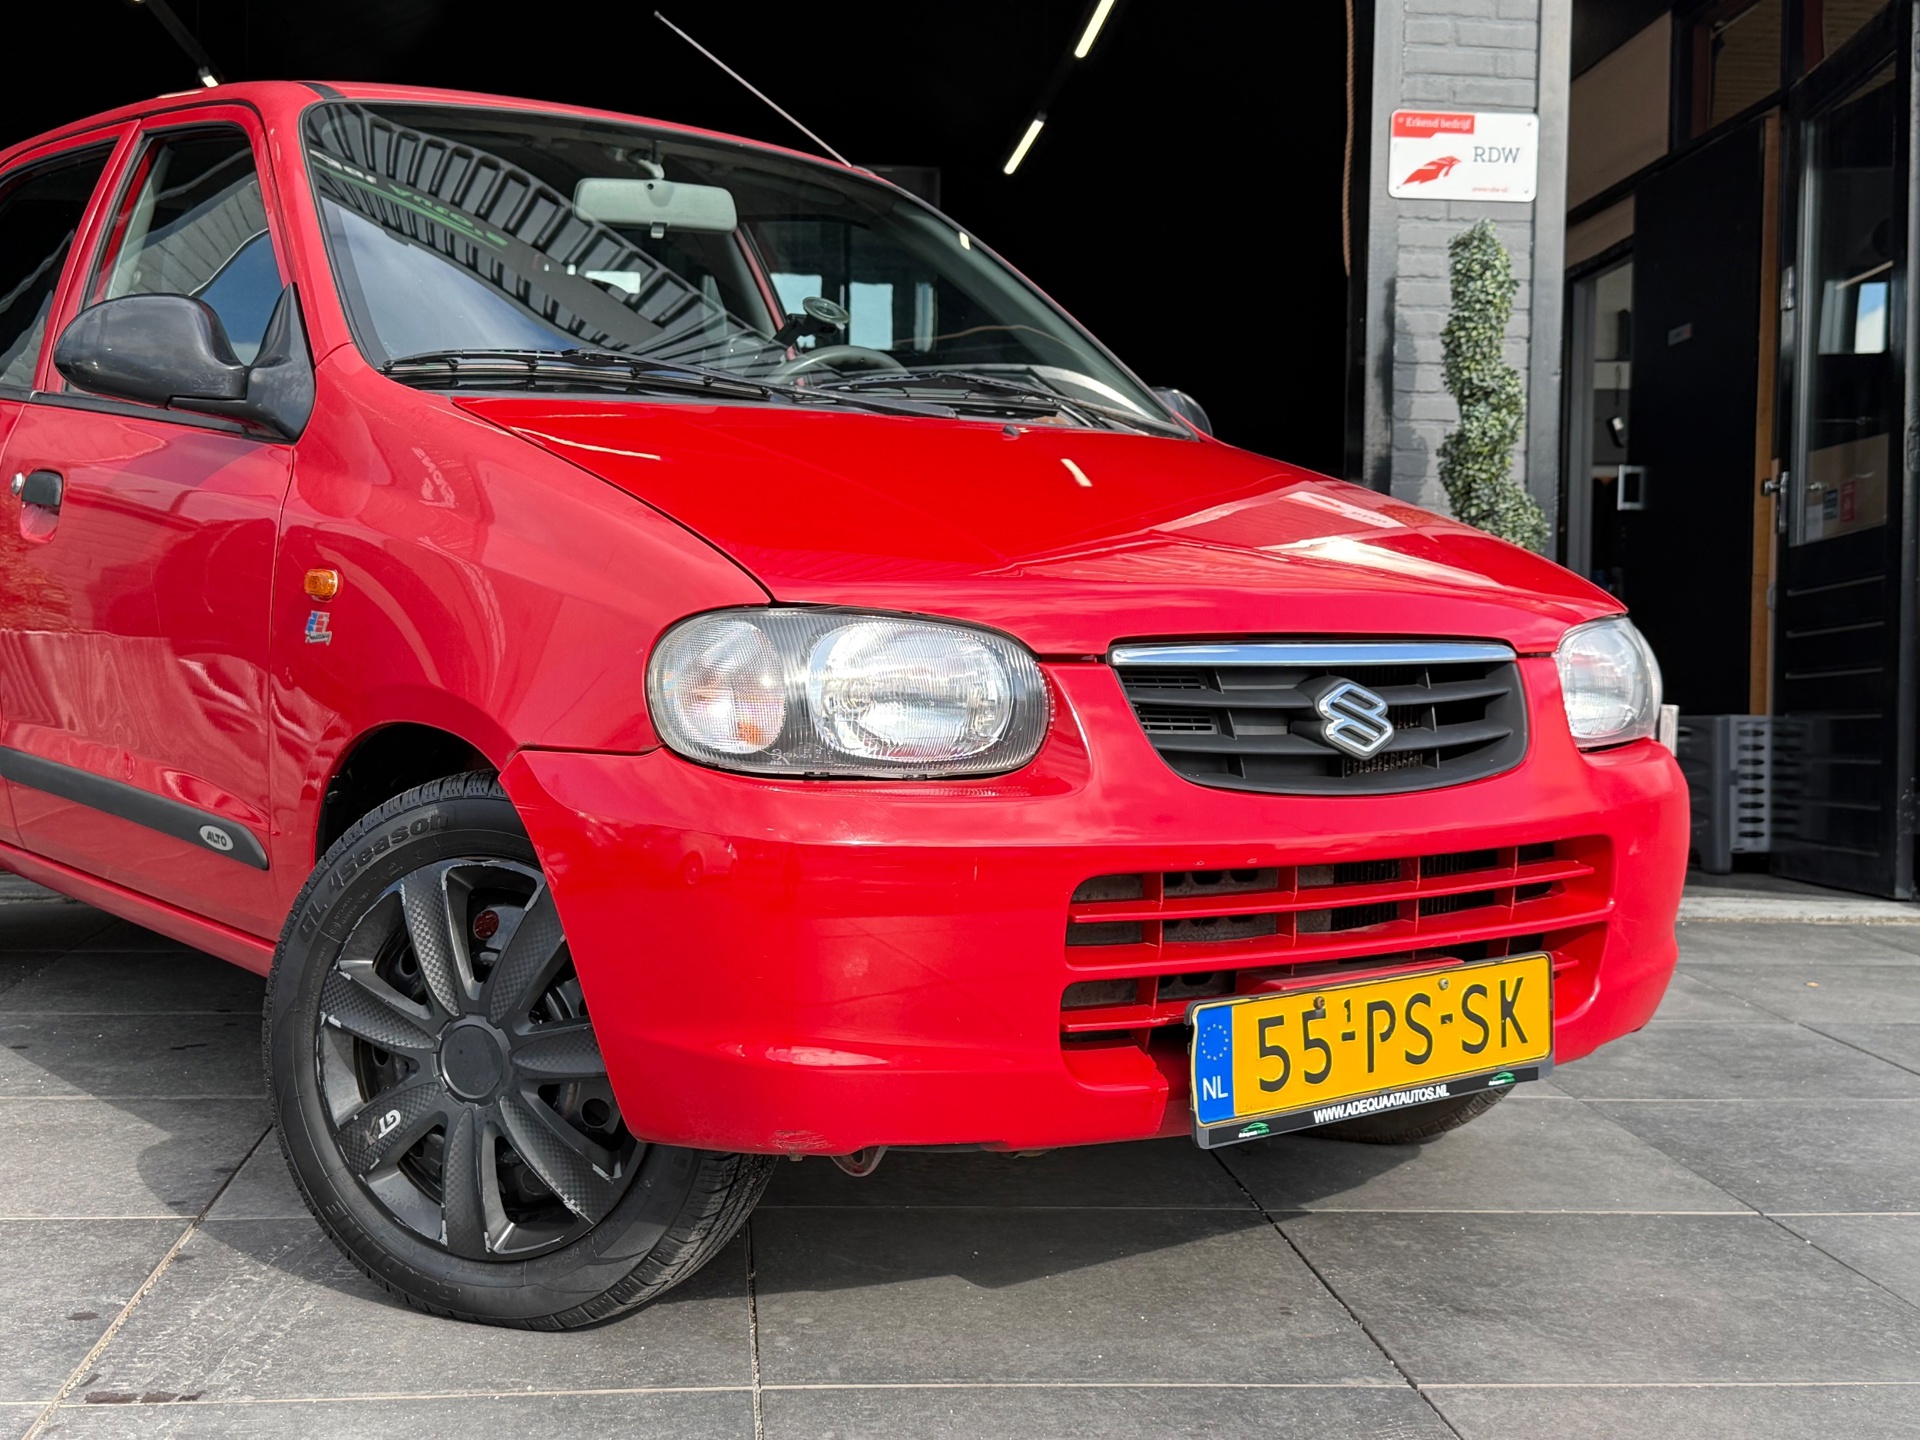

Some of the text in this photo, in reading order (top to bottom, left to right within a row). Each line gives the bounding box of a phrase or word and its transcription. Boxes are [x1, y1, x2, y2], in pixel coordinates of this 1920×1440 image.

[1406, 117, 1438, 128] Erkend
[1473, 146, 1520, 164] RDW
[206, 830, 227, 848] ALTO
[1258, 975, 1528, 1093] 55-PS-SK
[1202, 1075, 1228, 1102] NL
[1313, 1083, 1450, 1124] WWW.ADEQUAATAUTOS.NL
